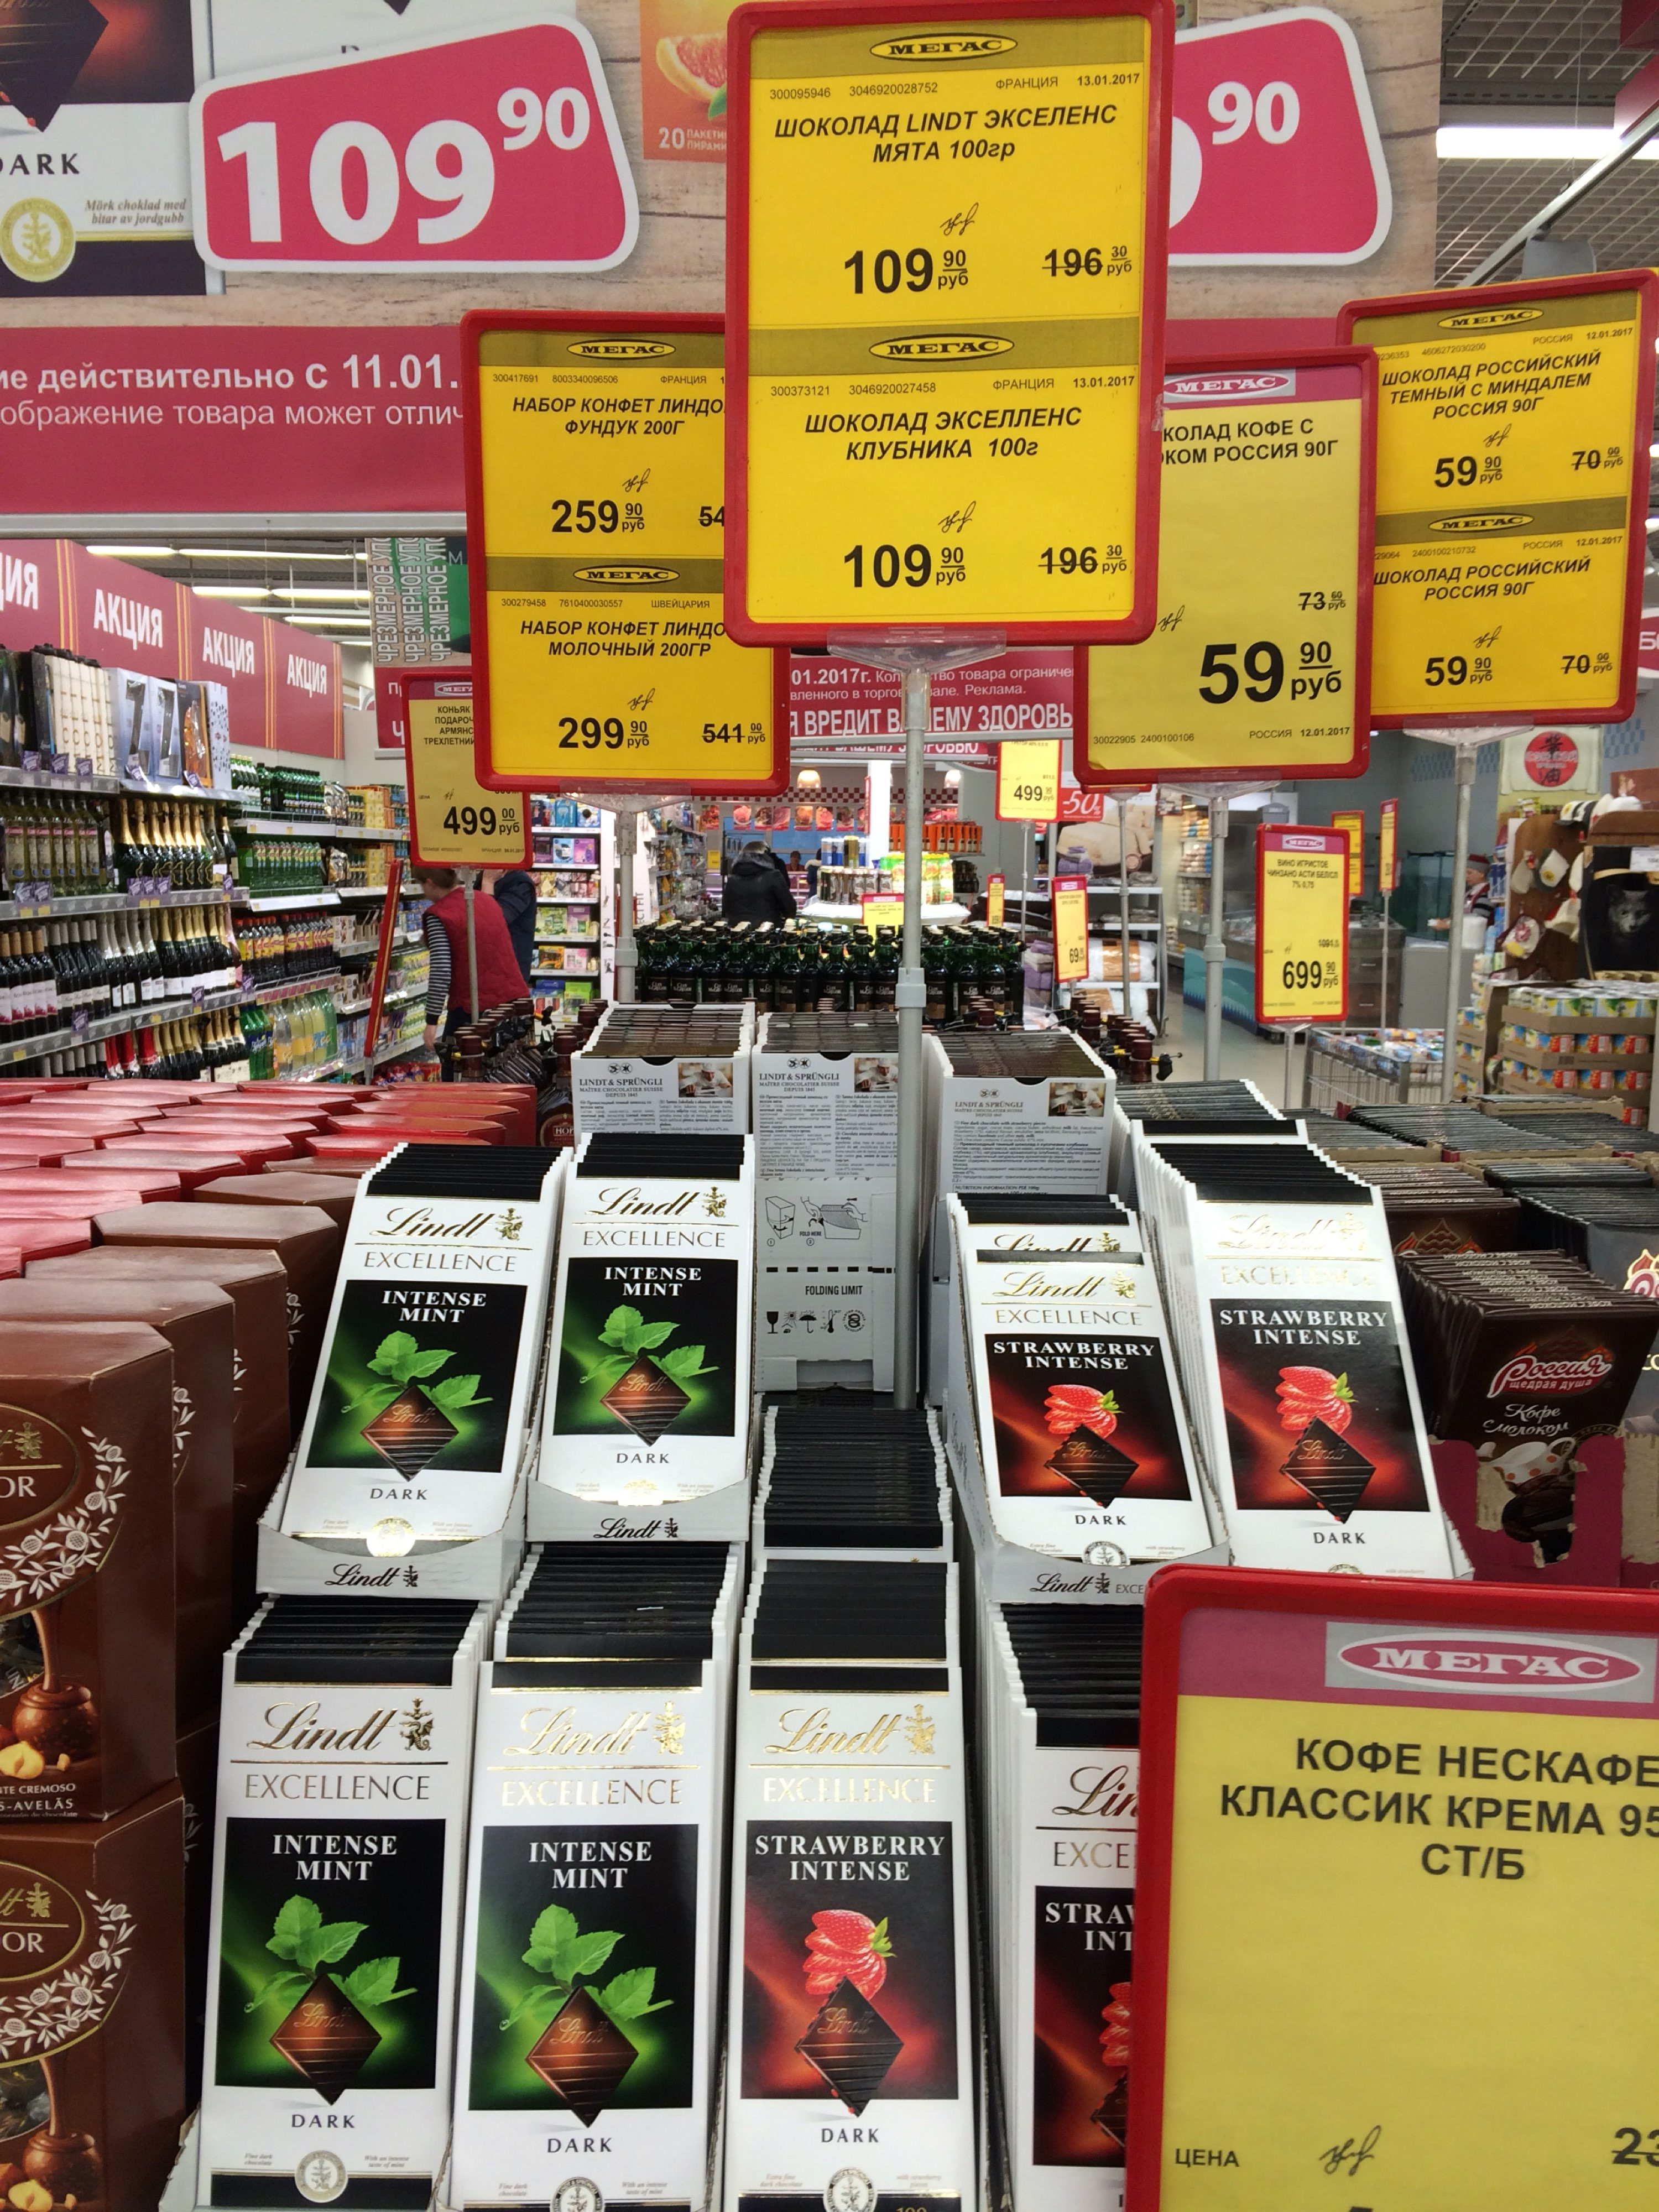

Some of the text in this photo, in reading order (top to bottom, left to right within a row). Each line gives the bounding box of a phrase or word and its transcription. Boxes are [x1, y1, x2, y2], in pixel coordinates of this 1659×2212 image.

[888, 40, 1003, 55] МЕГАС
[770, 73, 1140, 100] 300095946 3046920028752 ФРАНЦИЯ 13.01.2017
[775, 105, 1117, 138] ШОКОЛАД LINDT ЭКСЕЛЕНС
[1208, 81, 1300, 144] 90
[659, 127, 685, 149] 20
[873, 139, 1015, 163] МЯТА 100гр
[217, 87, 590, 245] 109 90
[85, 198, 186, 211] Mörk choklad med
[92, 212, 185, 226] bitar av jordgubb
[845, 248, 968, 294] 109 90 руб
[1042, 246, 1132, 276] 196 30 руб
[581, 346, 664, 354] МЕГАС
[38, 362, 294, 393] действительно
[306, 363, 327, 389] с
[343, 354, 457, 388] 11.01.
[1381, 349, 1601, 386] ШОКОЛАД РОССИЙСКИЙ
[493, 374, 706, 385] 300417691 8003340096506 ФРАНЦИЯ
[771, 375, 1135, 396] 300373121 3046920027458 ФРАНЦИЯ 13.01.2017
[1175, 376, 1276, 394] МЕГАС
[1391, 373, 1592, 404] ТЕМНЫЙ С МИНДАЛЕМ
[173, 405, 274, 430] товара
[286, 406, 375, 424] может
[513, 397, 723, 417] НАБОР КОНФЕТ ЛИНДО
[1433, 397, 1544, 419] РОССИЯ 90Г
[565, 420, 685, 438] ФУНДУК 200Г
[805, 407, 1082, 435] ШОКОЛАД ЭКСЕЛЛЕНС
[1238, 420, 1293, 437] КОФЕ
[1301, 419, 1313, 434] С
[847, 437, 1038, 460] КЛУБНИКА 100г
[1214, 442, 1297, 462] РОССИЯ
[1305, 440, 1338, 457] 90Г
[1572, 450, 1601, 470] 70
[1434, 456, 1477, 487] 59
[552, 499, 618, 533] 259
[1577, 535, 1623, 546] 12.01.2017
[502, 598, 709, 609] 300279458 7610400030557 ШВЕЙЦАРИЯ
[1298, 592, 1326, 611] 73
[93, 589, 163, 650] АКЦИЯ
[373, 566, 399, 661] ЧРЕЗМЕРНОЕ
[400, 566, 425, 661] ЧРЕЗМЕРНОЕ
[426, 566, 450, 661] ЧРЕЗМЕРНОЕ
[202, 627, 254, 678] АКЦИЯ
[549, 639, 711, 656] МОЛОЧНЫЙ 200ГР
[287, 654, 327, 698] АКЦИЯ
[959, 670, 1006, 682] товара
[1199, 641, 1341, 704] 59 90 руб
[965, 684, 1026, 695] Реклама.
[559, 717, 624, 749] 299
[702, 723, 745, 743] 541
[805, 708, 881, 737] ВРЕДИТ
[1093, 727, 1350, 744] 30022905 2400100106 РОССИЯ 12.01.2017
[1014, 785, 1042, 801] 499
[444, 806, 520, 836] 499 00 руб
[1277, 859, 1328, 868] ВИНО ИГРИСТОЕ
[1283, 961, 1338, 989] 699 90 руб
[370, 1208, 495, 1239] Lindt
[364, 1252, 517, 1272] EXCELLENCE
[382, 1291, 486, 1306] INTENSE
[806, 1285, 863, 1295] FOLDING LIMIT
[399, 1308, 465, 1322] MINT
[1220, 1310, 1387, 1327] STRAWBERRY
[1254, 1329, 1360, 1345] INTENSE
[1509, 1379, 1592, 1390] щедрая душа
[1504, 1404, 1561, 1424] Кофе
[370, 1488, 427, 1500] DARK
[1313, 1532, 1365, 1544] DARK
[325, 1564, 400, 1587] Lindt
[1373, 1647, 1610, 1679] МЕГАС
[247, 1702, 397, 1750] Lindt
[764, 1707, 901, 1755] Lindt
[1297, 1738, 1659, 1787] КОФЕ НЕСКАФЕ
[19, 1783, 76, 1794] CREMOSO
[246, 1774, 430, 1800] EXCELLENCE
[763, 1777, 936, 1802] EXCELLENCE
[1222, 1785, 1432, 1825] КЛАССИК
[1447, 1796, 1605, 1835] КРЕМА
[273, 1835, 397, 1855] INTENSE
[756, 1835, 944, 1855] STRAWBERRY
[296, 1861, 372, 1880] MINT
[790, 1861, 909, 1881] INTENSE
[1422, 1843, 1524, 1880] СТ/Б
[292, 2114, 354, 2128] DARK
[822, 2128, 878, 2143] DARK
[1176, 2148, 1239, 2168] ЦЕНА
